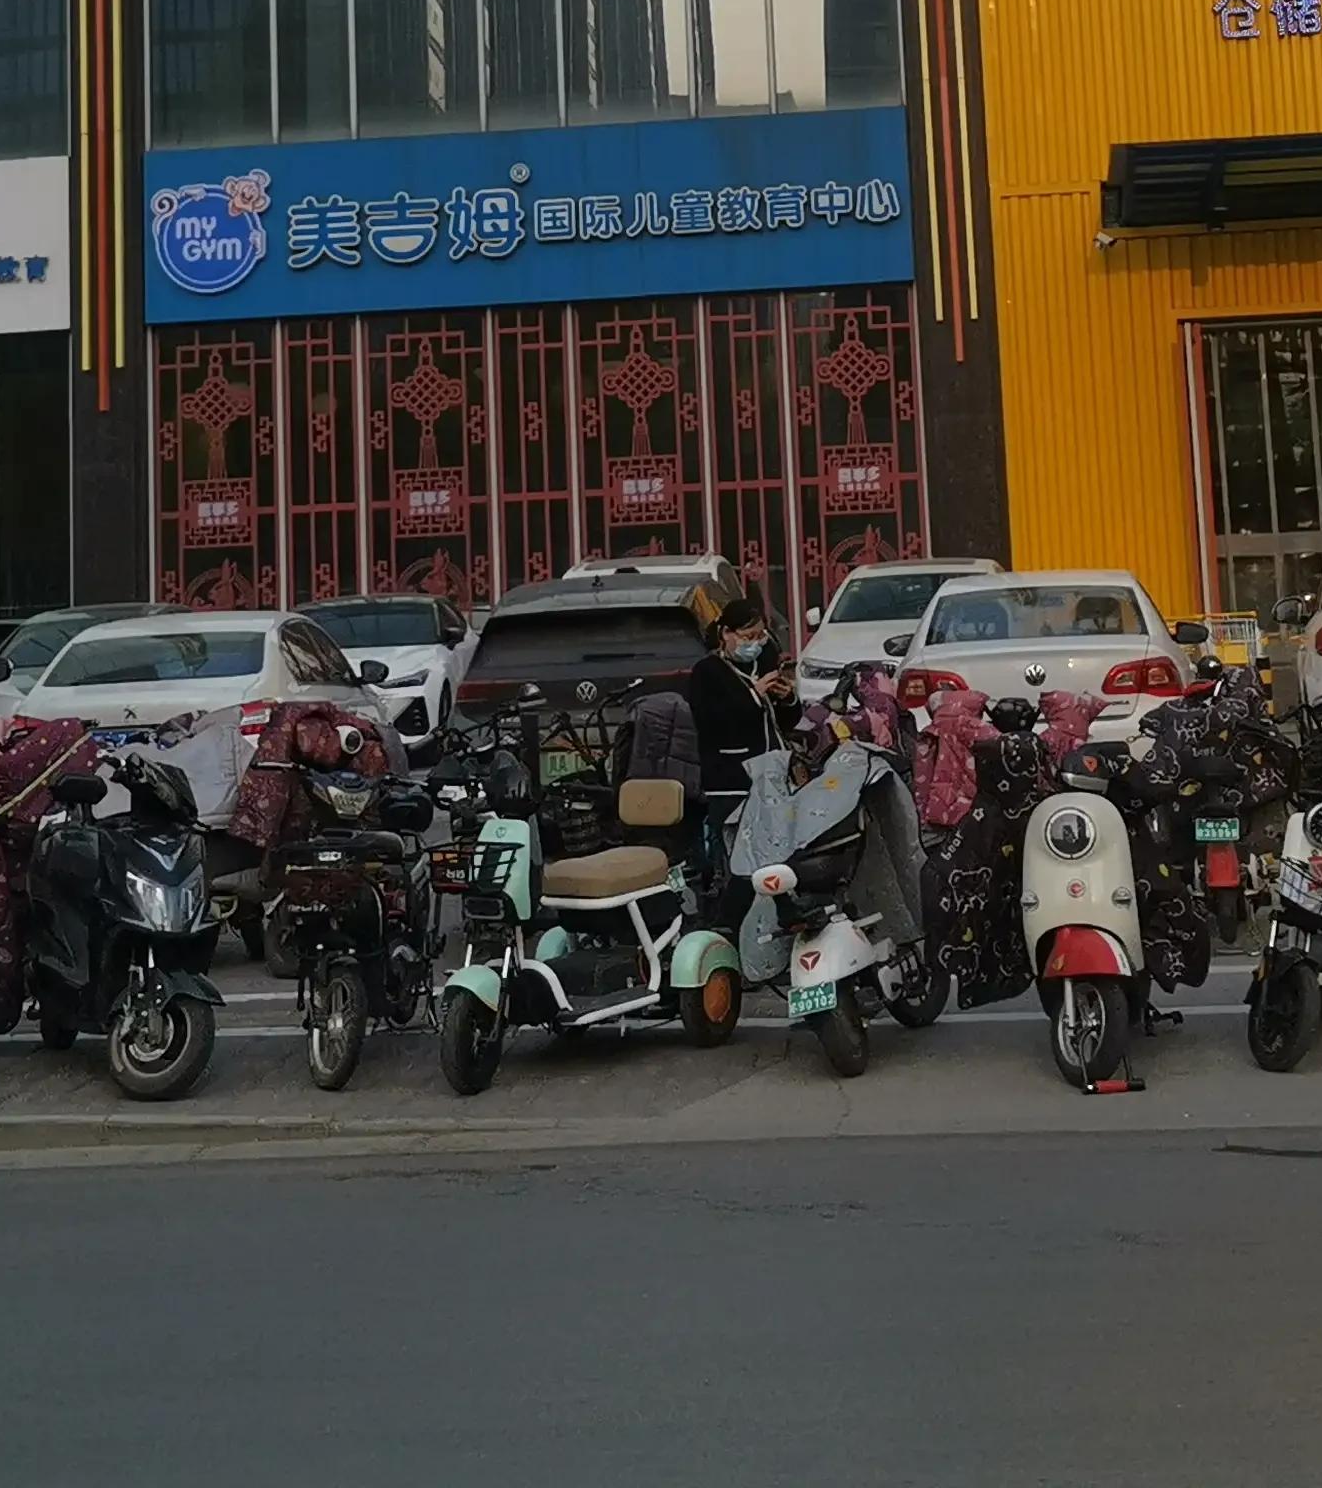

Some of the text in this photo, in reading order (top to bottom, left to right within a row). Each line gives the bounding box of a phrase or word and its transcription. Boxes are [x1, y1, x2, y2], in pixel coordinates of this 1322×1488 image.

[287, 178, 900, 270] 美吉姆 国际儿童教育中心
